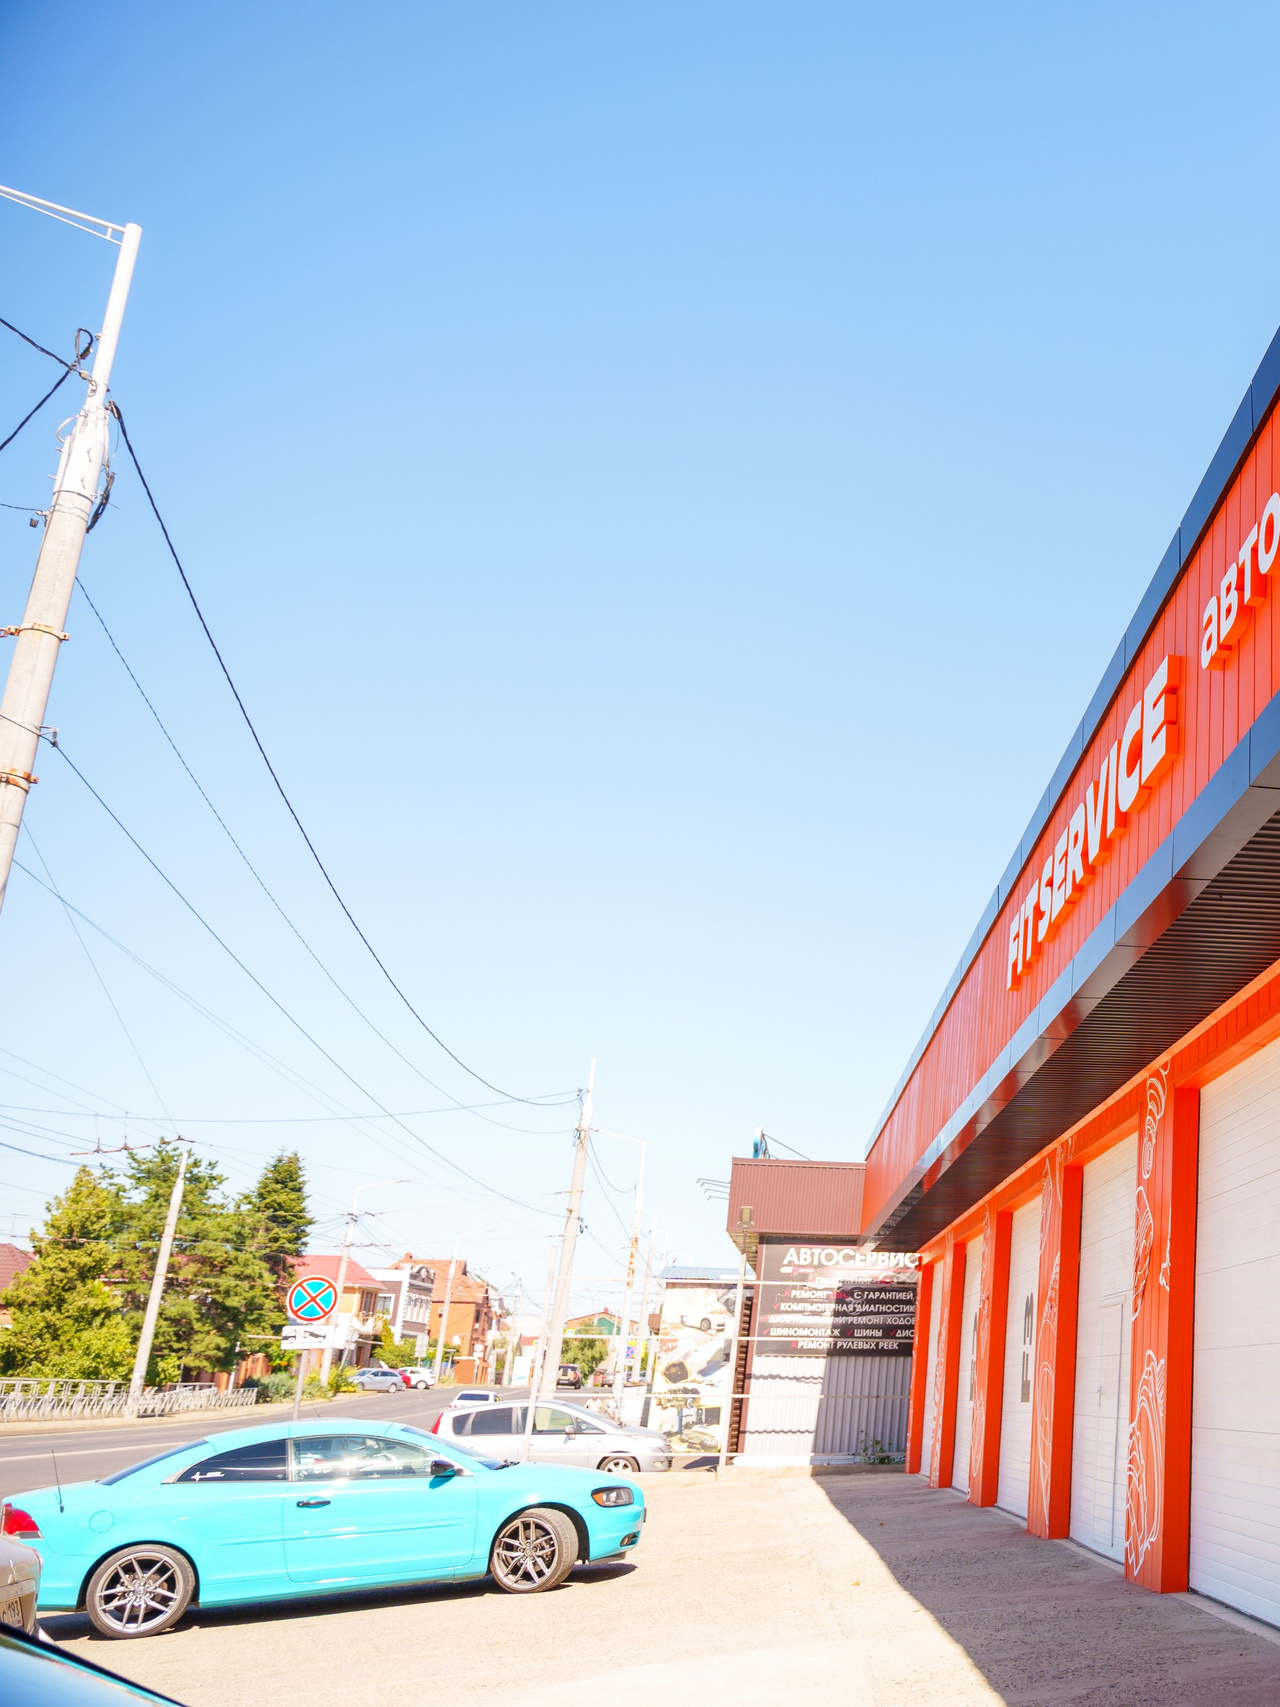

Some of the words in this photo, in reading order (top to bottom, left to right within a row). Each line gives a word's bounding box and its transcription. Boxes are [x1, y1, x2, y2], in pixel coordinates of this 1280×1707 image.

[1006, 877, 1040, 992] FIT
[1038, 654, 1176, 943] SERVICE
[782, 1247, 920, 1267] АВТОСЕРВИС
[791, 1291, 828, 1300] РЕМОНТ
[864, 1291, 913, 1300] ГАРАНТИЕЙ
[780, 1302, 854, 1312] КОМПЬЮТЕРНАЯ
[848, 1317, 883, 1325] РЕМОНТ
[770, 1328, 840, 1337] ШИНОМОНТАЖ
[854, 1329, 882, 1337] ШИНЫ
[797, 1341, 834, 1349] РЕМОНТ
[837, 1341, 876, 1349] РУЛЕВЫХ
[878, 1341, 899, 1350] РЕЕК
